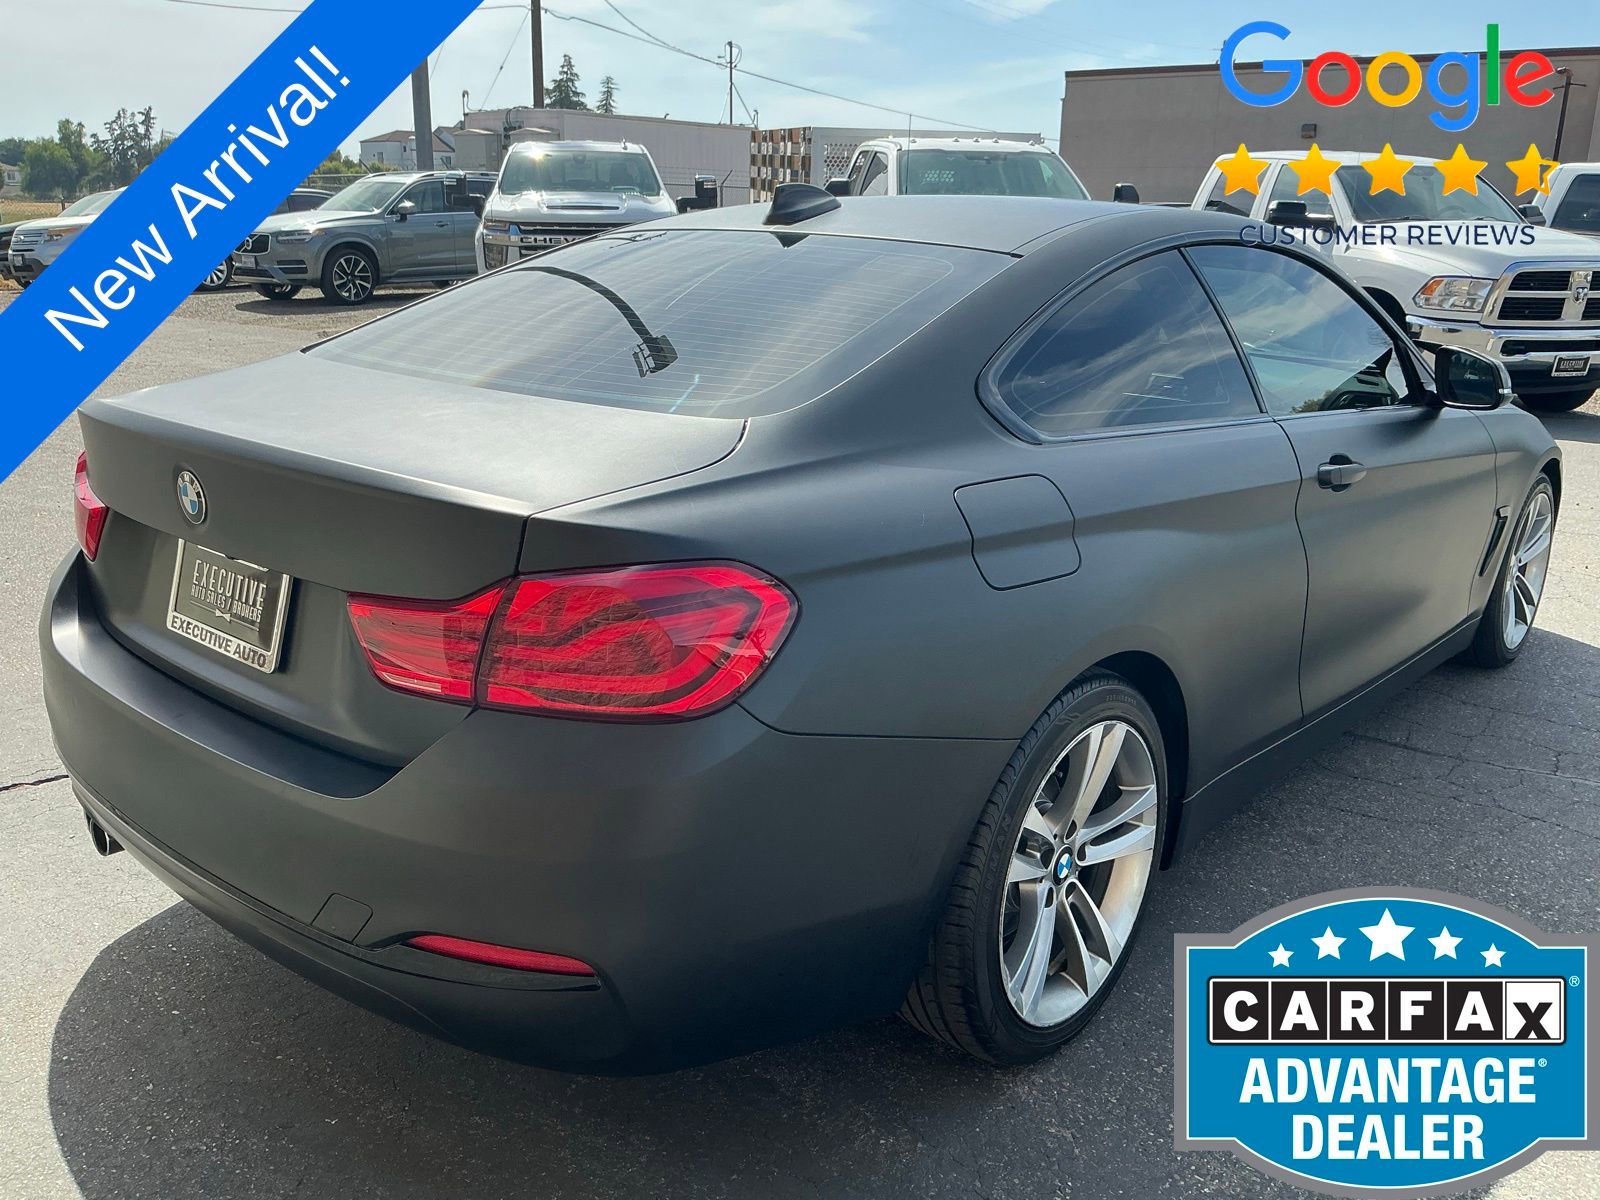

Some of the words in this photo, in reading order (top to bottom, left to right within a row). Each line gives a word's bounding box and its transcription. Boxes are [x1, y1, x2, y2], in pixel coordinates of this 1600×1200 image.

[190, 584, 206, 601] AUTO
[206, 588, 226, 609] SALES
[232, 600, 262, 623] BROKERS
[193, 559, 267, 611] EXECUTIVE
[170, 614, 233, 655] EXECUTIVE
[232, 643, 267, 668] AUTO
